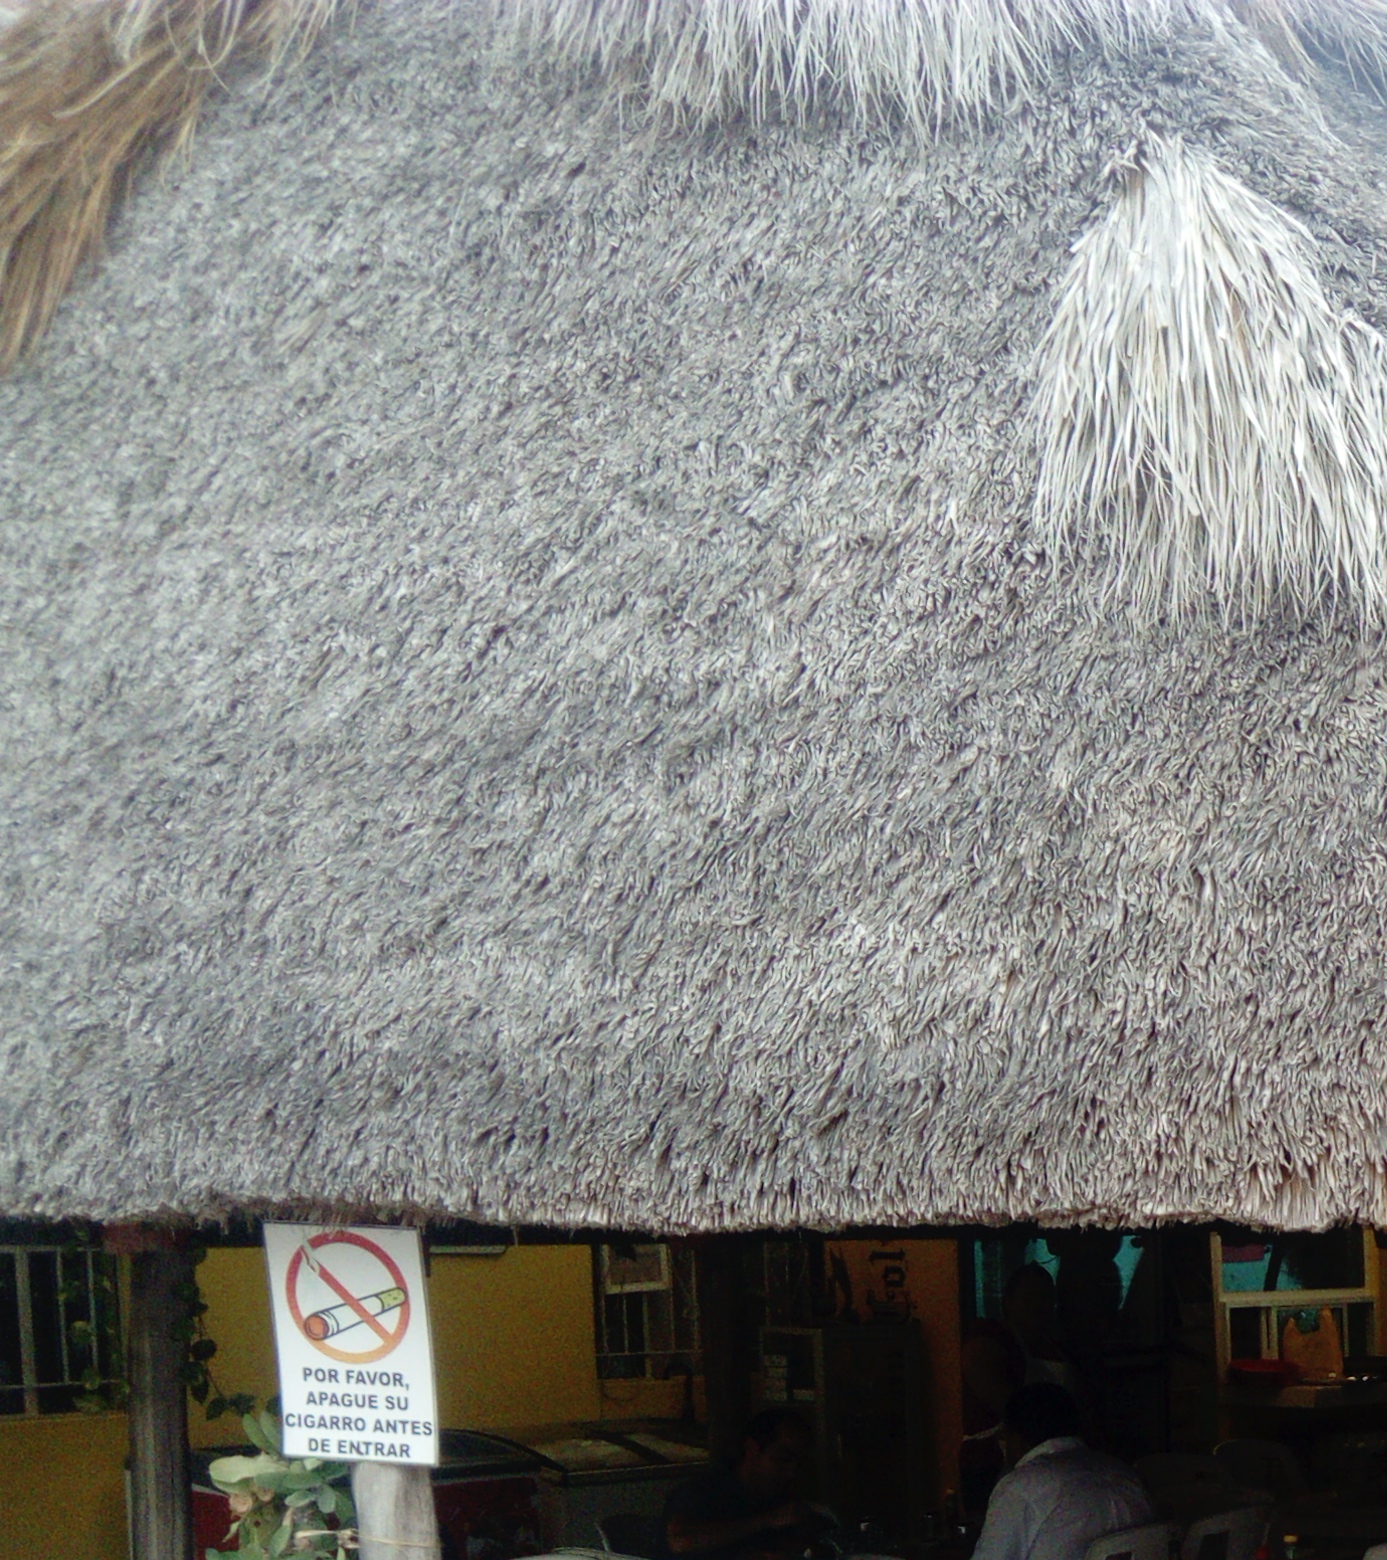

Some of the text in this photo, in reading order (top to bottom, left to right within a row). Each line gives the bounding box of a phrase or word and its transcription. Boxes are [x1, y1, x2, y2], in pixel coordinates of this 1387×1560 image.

[302, 1367, 410, 1391] POR FAVOR,
[306, 1391, 409, 1411] APAGUE SU
[285, 1413, 433, 1436] CIGARRO ANTES
[308, 1437, 411, 1458] DE ENTRAR
